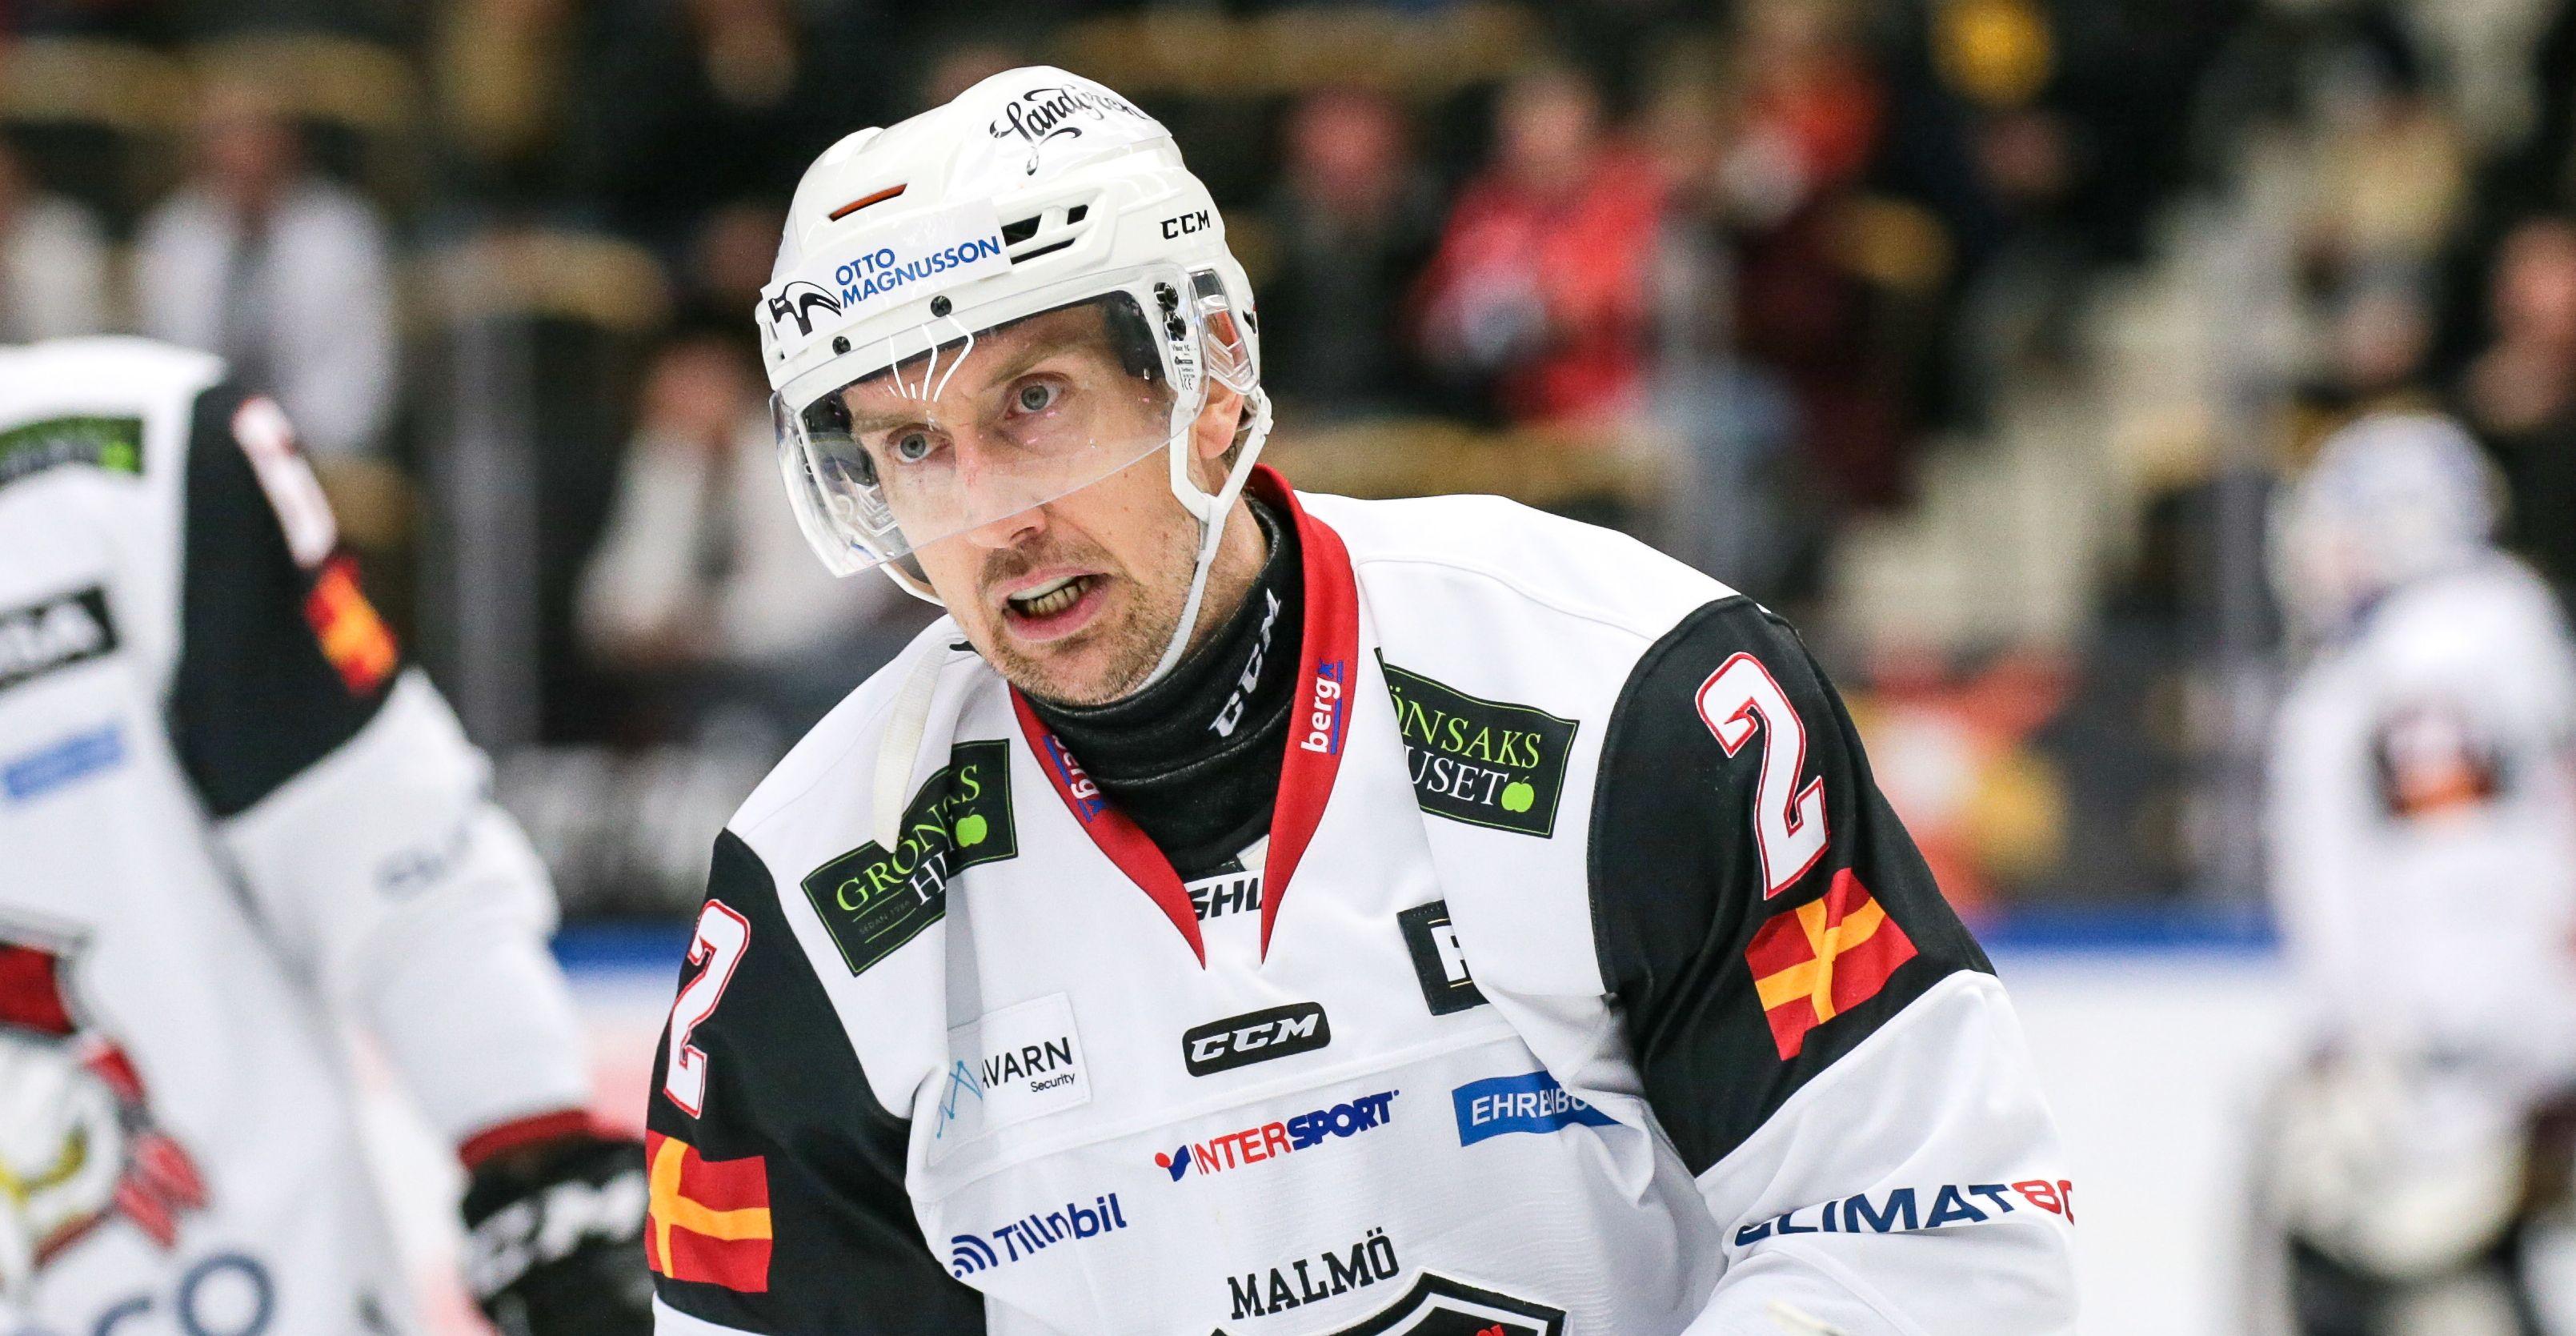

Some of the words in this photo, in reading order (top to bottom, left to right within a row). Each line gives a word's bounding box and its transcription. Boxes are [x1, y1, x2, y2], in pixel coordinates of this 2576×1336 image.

[1160, 209, 1211, 240] CCM
[835, 247, 895, 286] OTTO
[840, 235, 1001, 310] MAGNUSSON
[1207, 587, 1281, 737] CCM
[1695, 651, 1830, 901] 2
[663, 897, 751, 1120] 2
[1191, 1013, 1320, 1063] CCM
[1030, 1073, 1076, 1093] Security
[1190, 1090, 1393, 1177] INTERSPORT
[1227, 1226, 1400, 1320] MALMÖ
